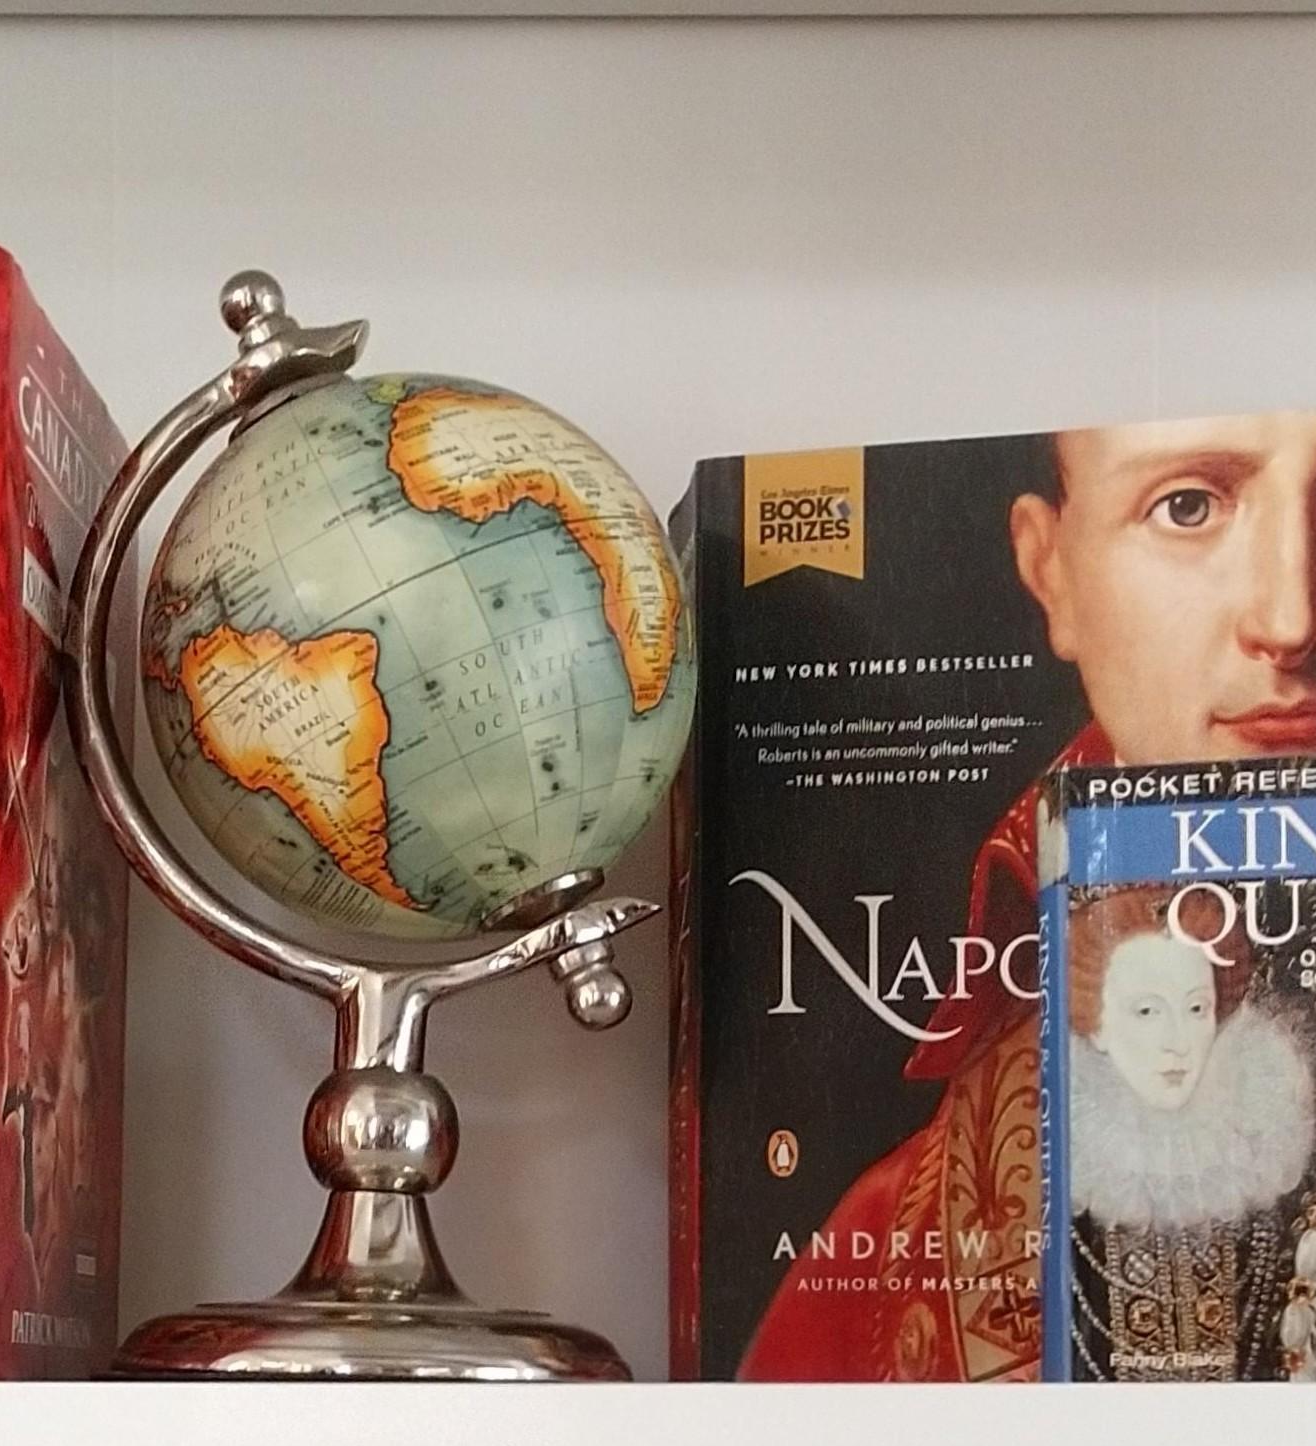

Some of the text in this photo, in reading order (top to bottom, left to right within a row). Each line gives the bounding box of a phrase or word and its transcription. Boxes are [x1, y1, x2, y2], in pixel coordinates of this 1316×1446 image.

[760, 497, 833, 521] BOOK
[760, 520, 850, 544] PRIZES
[736, 654, 1034, 682] NEW YORK TIMES BESTSELLER
[752, 722, 800, 739] thrilling
[803, 720, 827, 735] tale
[831, 719, 844, 734] of
[846, 717, 894, 735] military
[898, 716, 923, 731] and
[926, 713, 978, 732] political
[758, 747, 808, 764] Roberts
[811, 747, 823, 761] is
[825, 749, 841, 761] an
[843, 741, 927, 760] uncommonly
[930, 740, 969, 759] gifted
[1089, 772, 1221, 799] POCKET
[773, 1231, 987, 1261] ANDREW
[797, 1277, 879, 1292] AUTHOR
[888, 1277, 914, 1291] OF
[921, 1276, 1016, 1292] MASTERS
